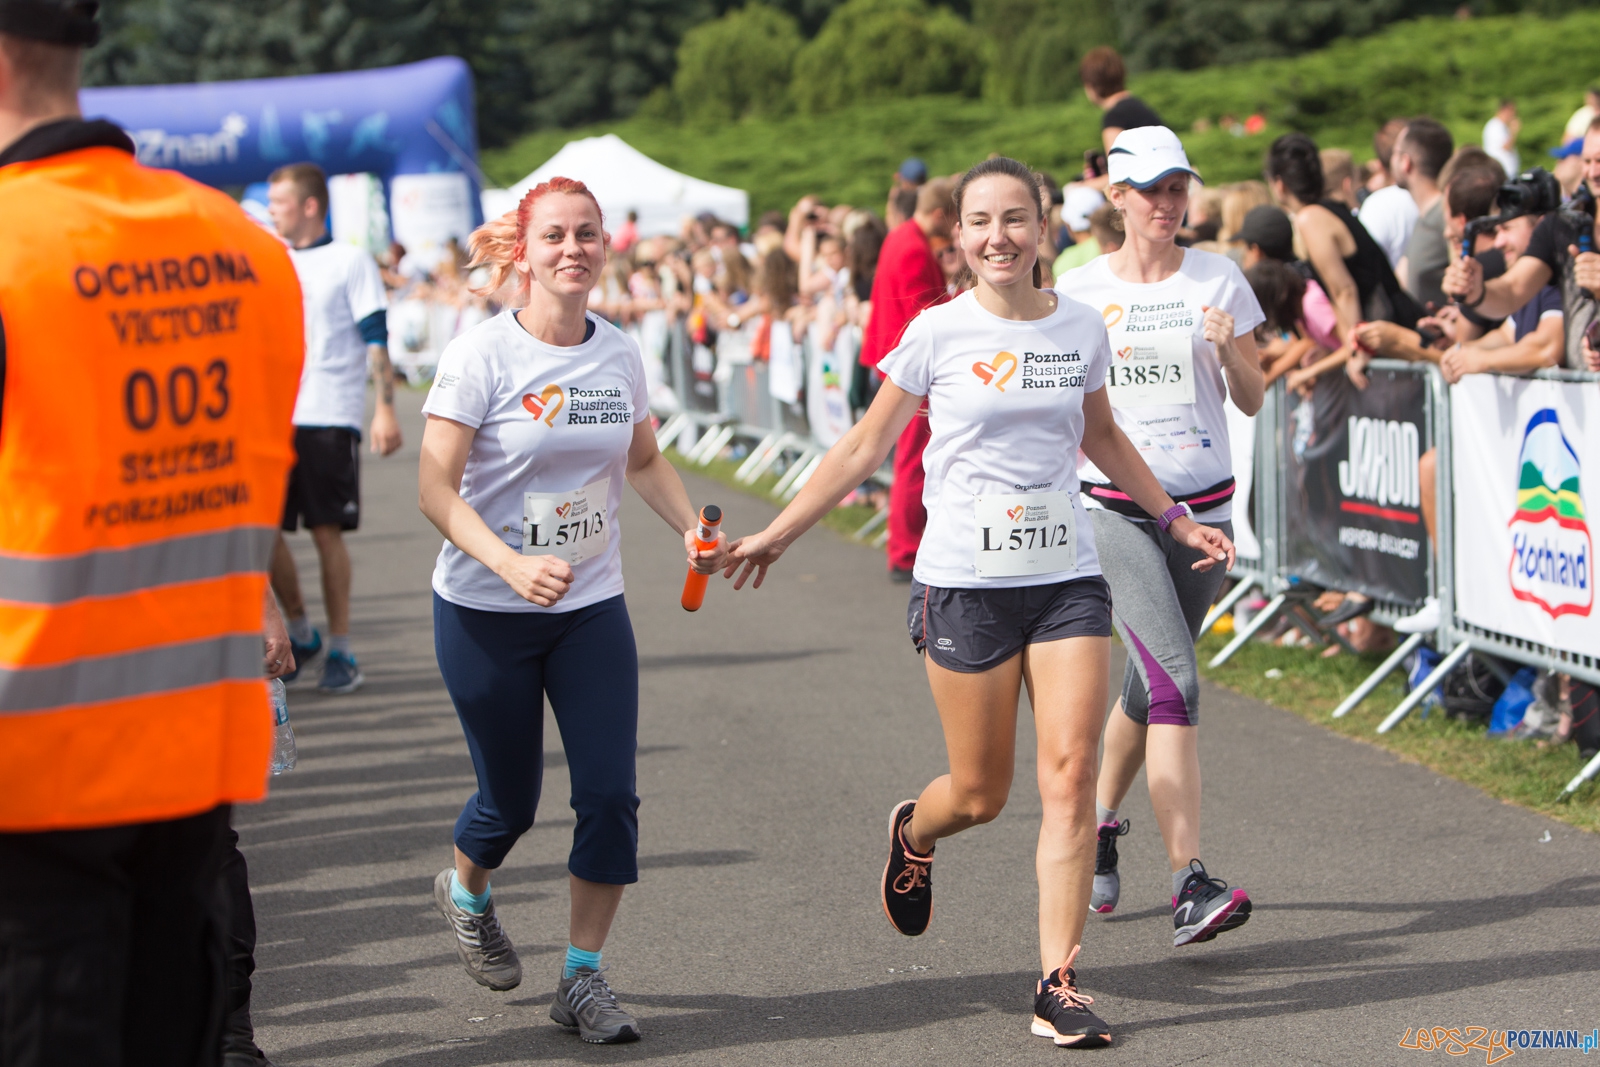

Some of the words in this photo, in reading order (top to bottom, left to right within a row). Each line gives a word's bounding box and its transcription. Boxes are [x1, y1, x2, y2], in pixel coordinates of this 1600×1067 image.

[74, 252, 259, 299] OCHRONA
[1129, 299, 1185, 313] Poznań
[108, 297, 241, 346] VICTORY
[1127, 309, 1192, 323] Business
[1125, 324, 1156, 332] Run
[1159, 317, 1193, 330] 2016
[1023, 350, 1081, 364] Poznań
[1022, 364, 1089, 377] Business
[1021, 378, 1056, 389] Run
[124, 358, 231, 433] 003
[568, 386, 621, 398] Poznań
[569, 398, 628, 411] Business
[567, 412, 598, 425] Run
[600, 412, 631, 424] 2016
[528, 523, 550, 547] L
[555, 511, 604, 546] 571/3
[980, 526, 1003, 552] L
[1008, 523, 1068, 551] 571/2
[1513, 532, 1587, 590] Hochland
